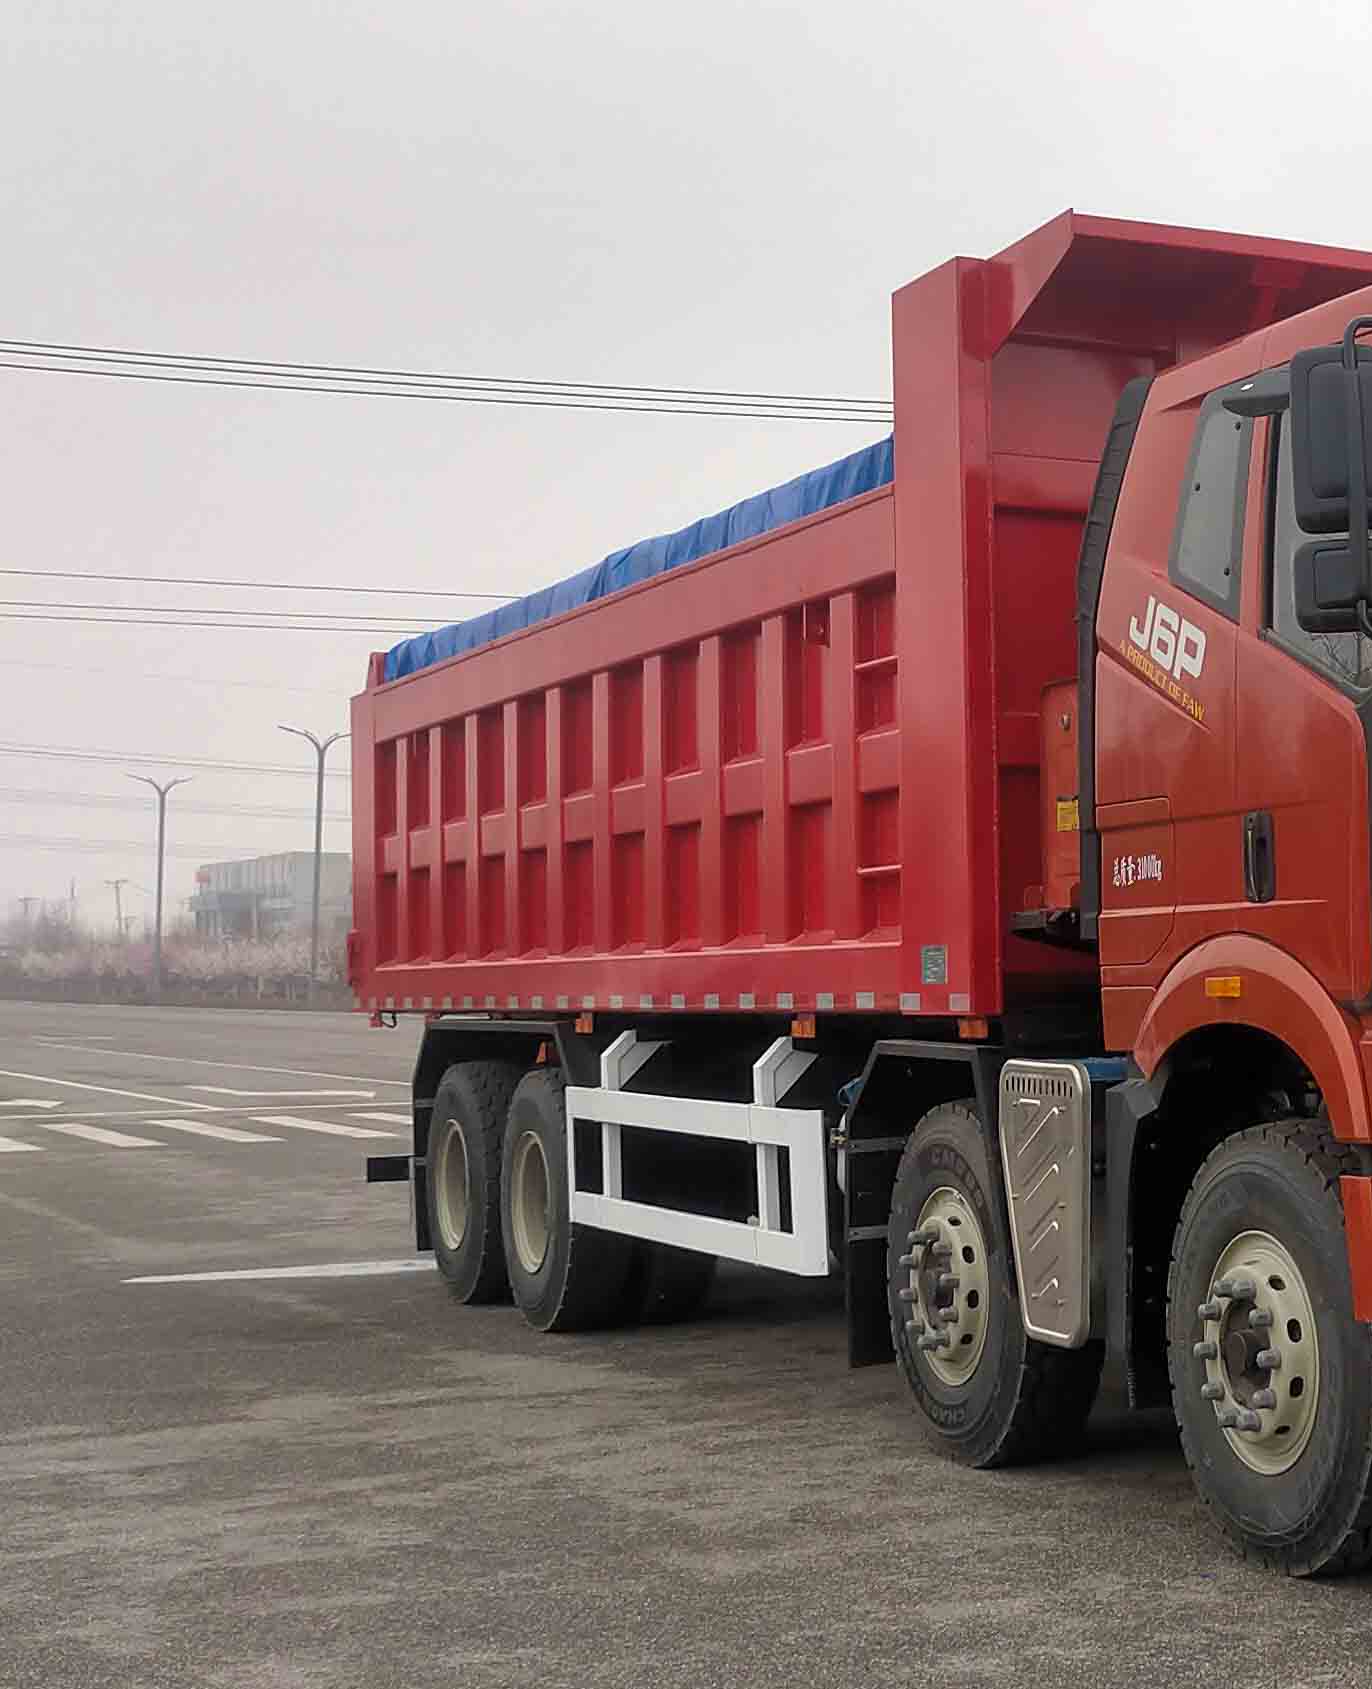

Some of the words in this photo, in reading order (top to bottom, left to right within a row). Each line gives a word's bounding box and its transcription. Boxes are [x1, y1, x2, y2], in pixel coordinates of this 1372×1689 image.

[1129, 594, 1207, 681] J6P
[1168, 680, 1181, 700] OF
[1182, 692, 1206, 721] FAW
